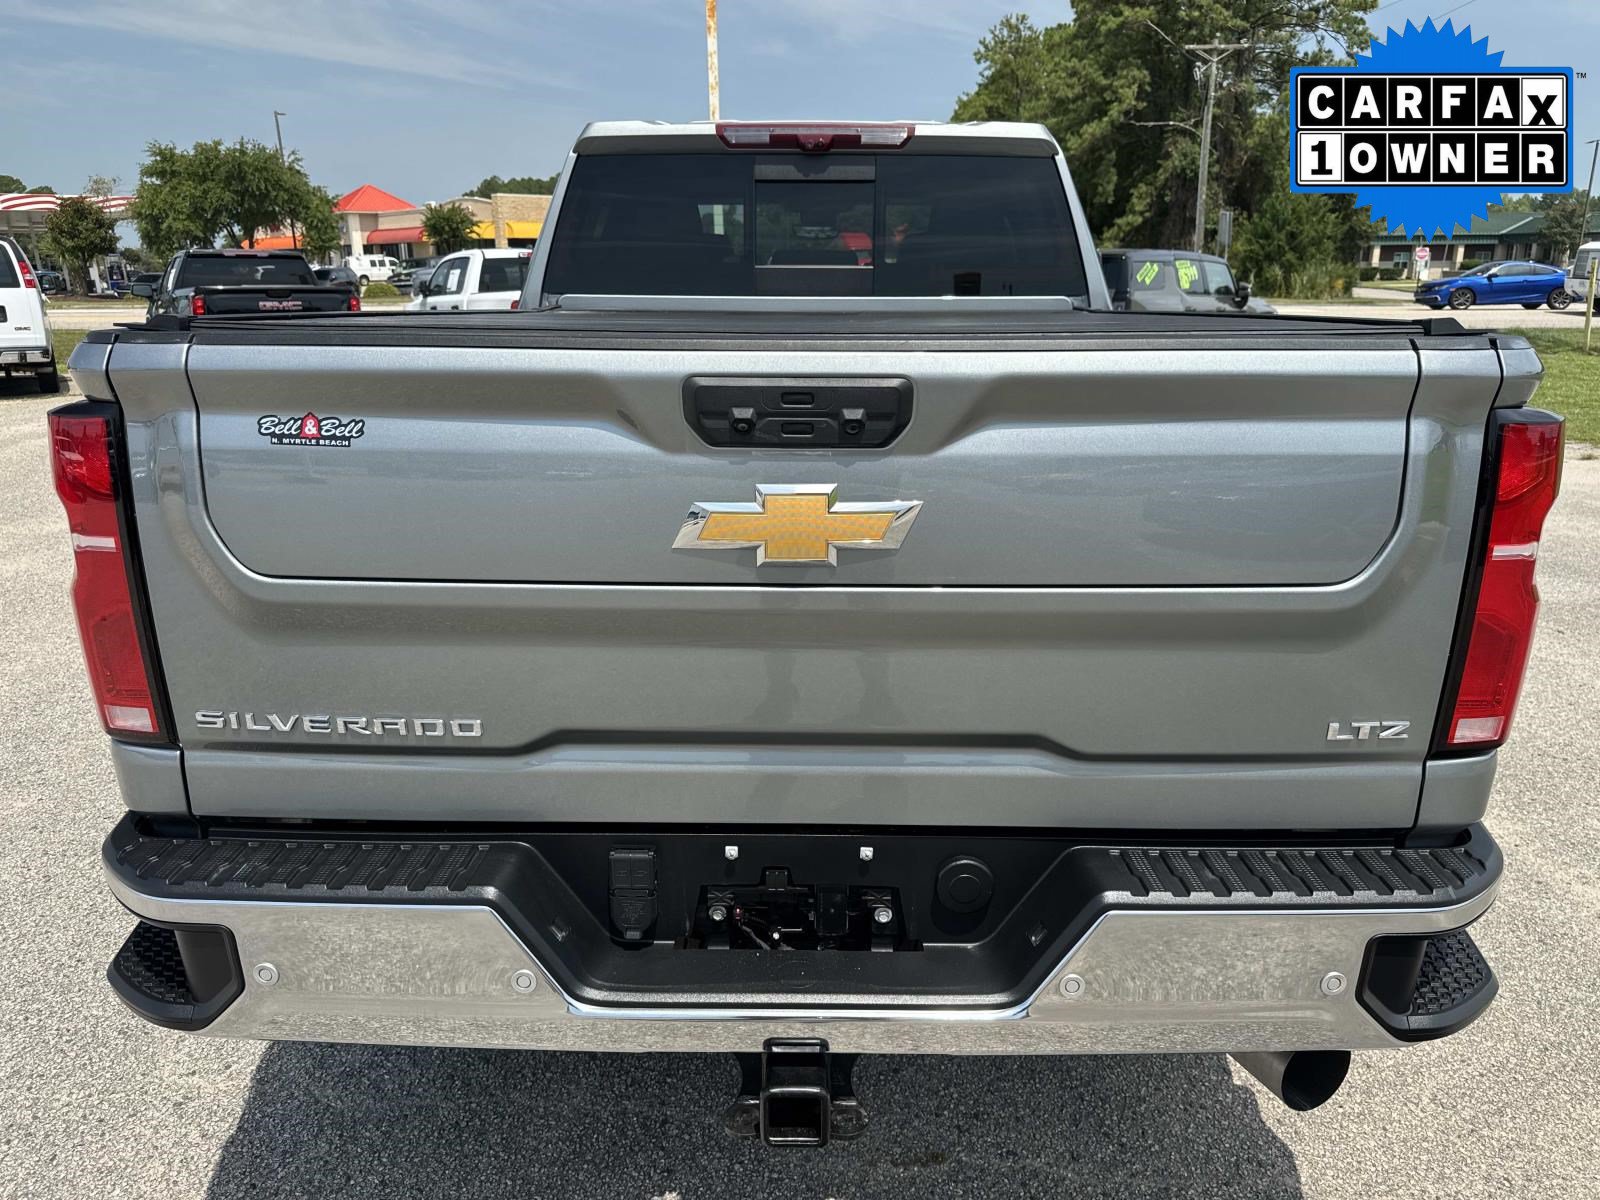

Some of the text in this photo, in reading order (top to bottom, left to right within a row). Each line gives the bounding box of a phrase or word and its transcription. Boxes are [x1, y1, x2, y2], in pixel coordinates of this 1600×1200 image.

[259, 301, 303, 311] GMC
[259, 417, 363, 437] Bell & Bell
[195, 710, 483, 738] SILVERADO
[1326, 721, 1411, 740] LTZ
